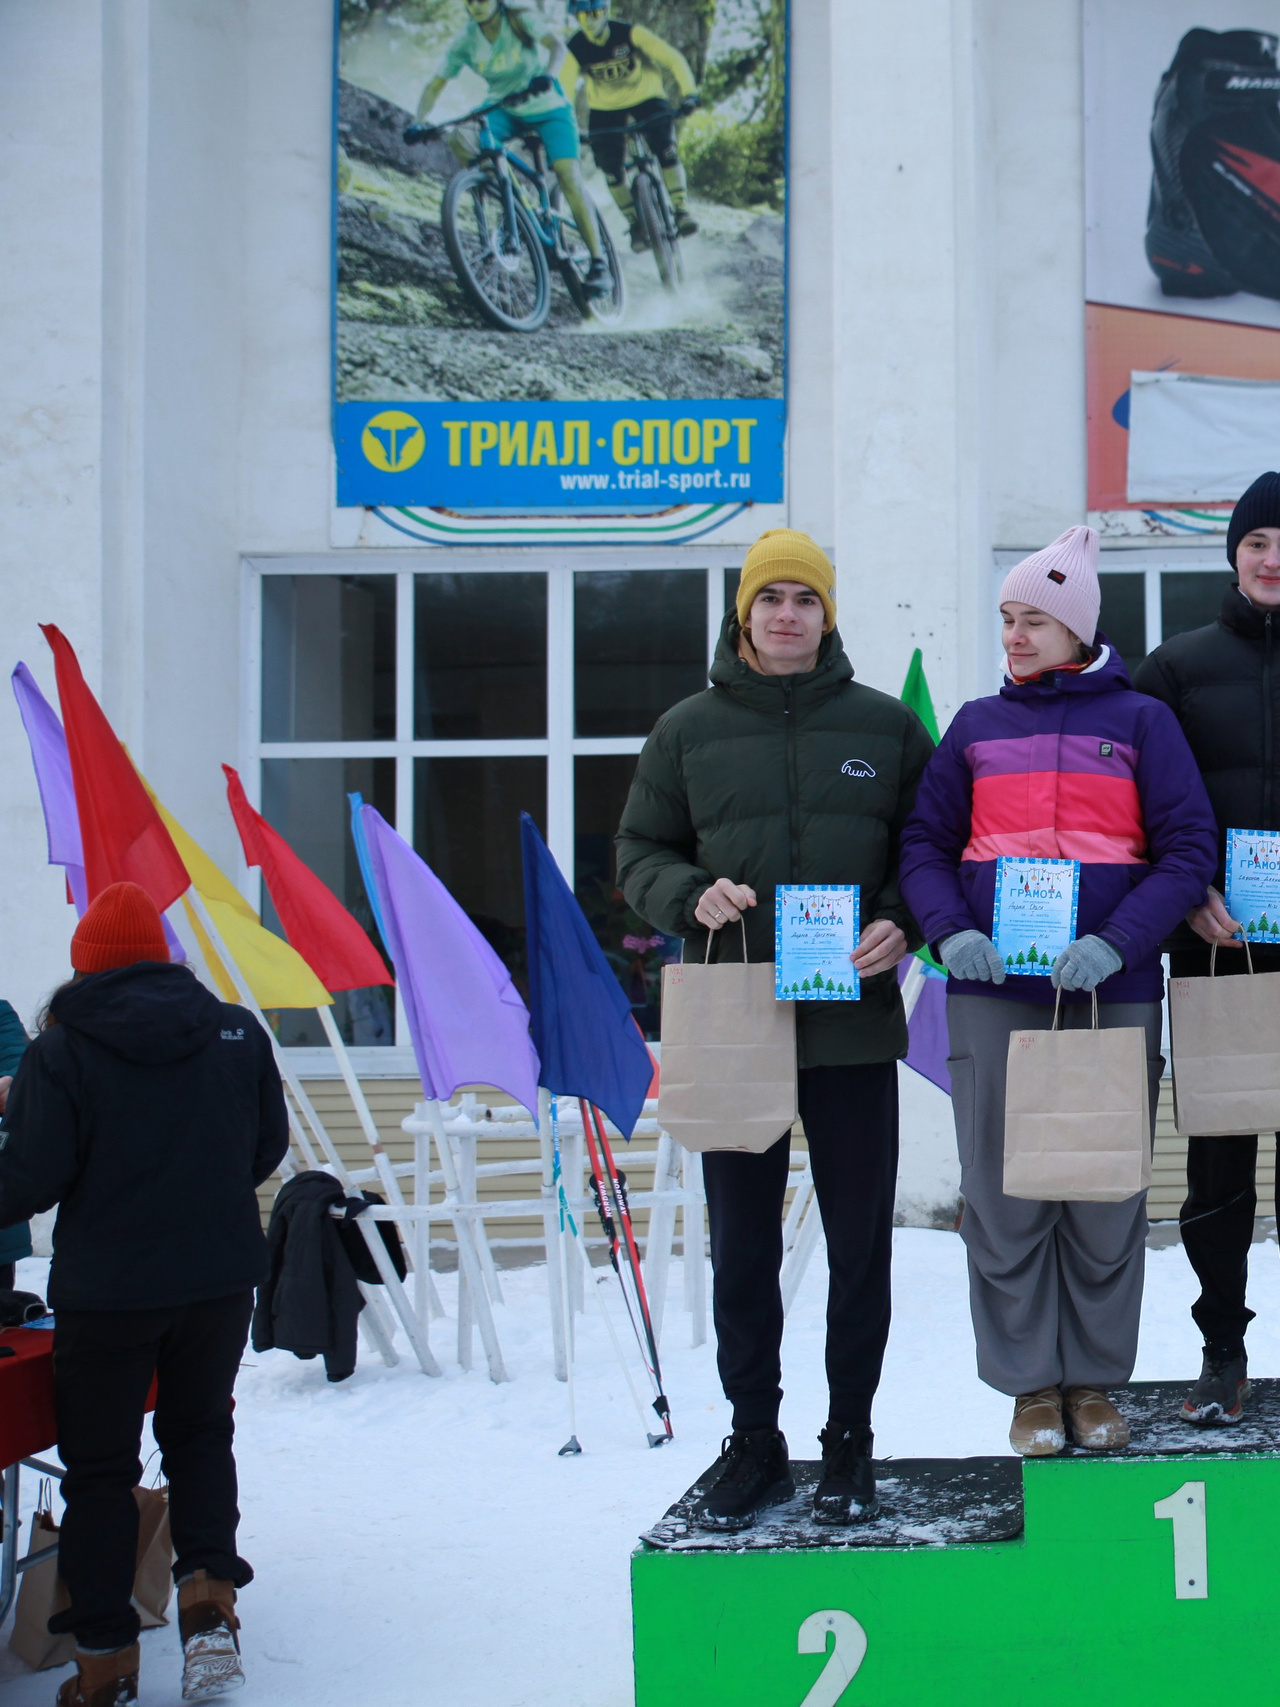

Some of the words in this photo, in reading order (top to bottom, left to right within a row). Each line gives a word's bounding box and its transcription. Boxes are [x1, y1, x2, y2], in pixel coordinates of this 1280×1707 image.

[560, 469, 751, 493] www.trial-sport.ru
[1010, 888, 1062, 899] ГРАМОТА
[790, 916, 844, 926] ГРАМОТА
[598, 1180, 613, 1218] NORDWAY
[612, 1178, 628, 1216] NORDWAY
[1153, 1481, 1209, 1600] 1
[798, 1609, 867, 1707] 2
